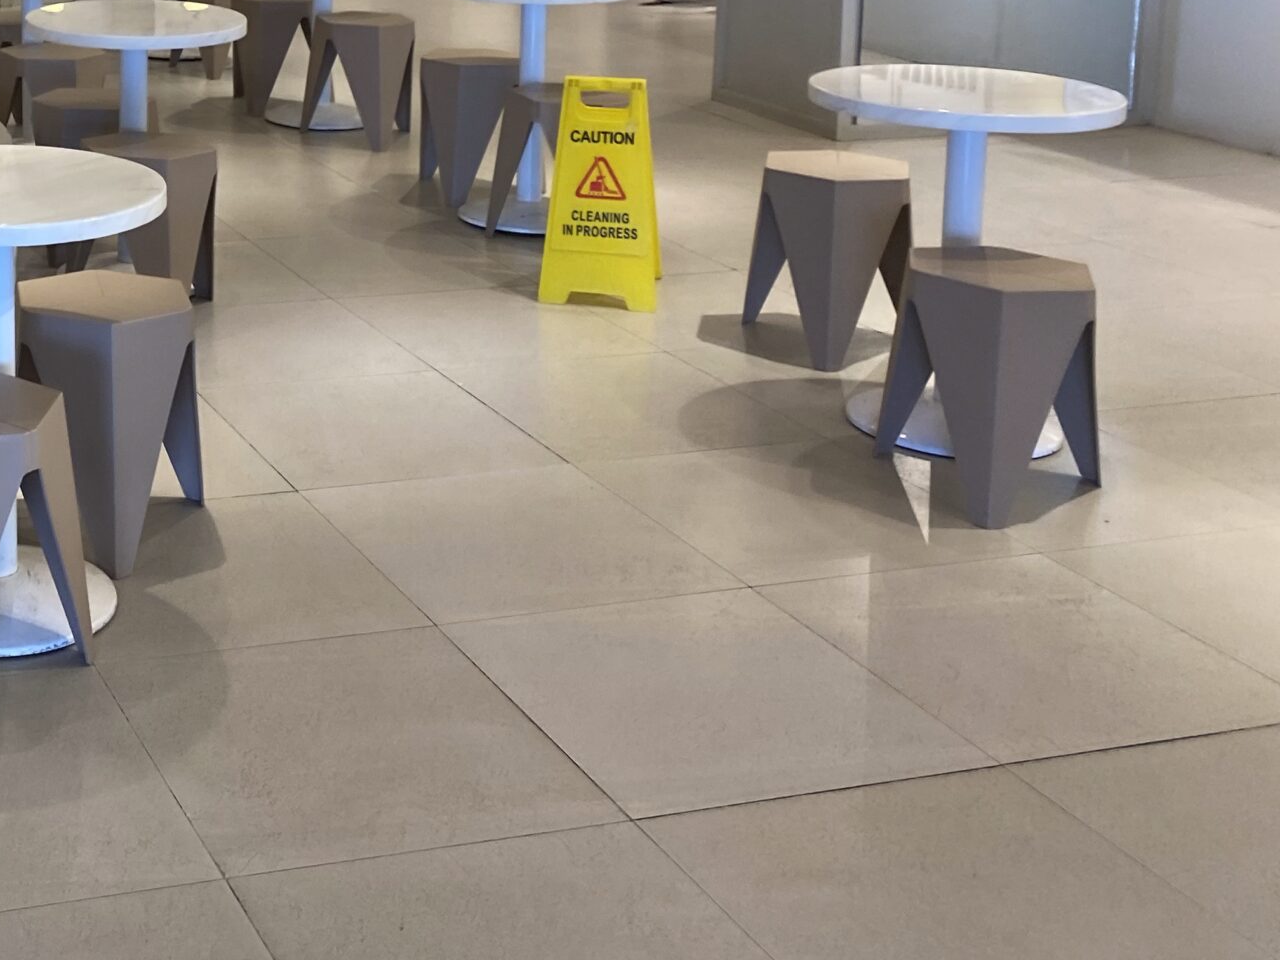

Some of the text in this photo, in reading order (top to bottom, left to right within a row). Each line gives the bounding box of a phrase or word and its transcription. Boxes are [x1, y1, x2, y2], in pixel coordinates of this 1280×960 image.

[570, 130, 635, 145] CAUTION
[571, 210, 630, 224] CLEANING
[562, 224, 638, 240] IN PROGRESS
